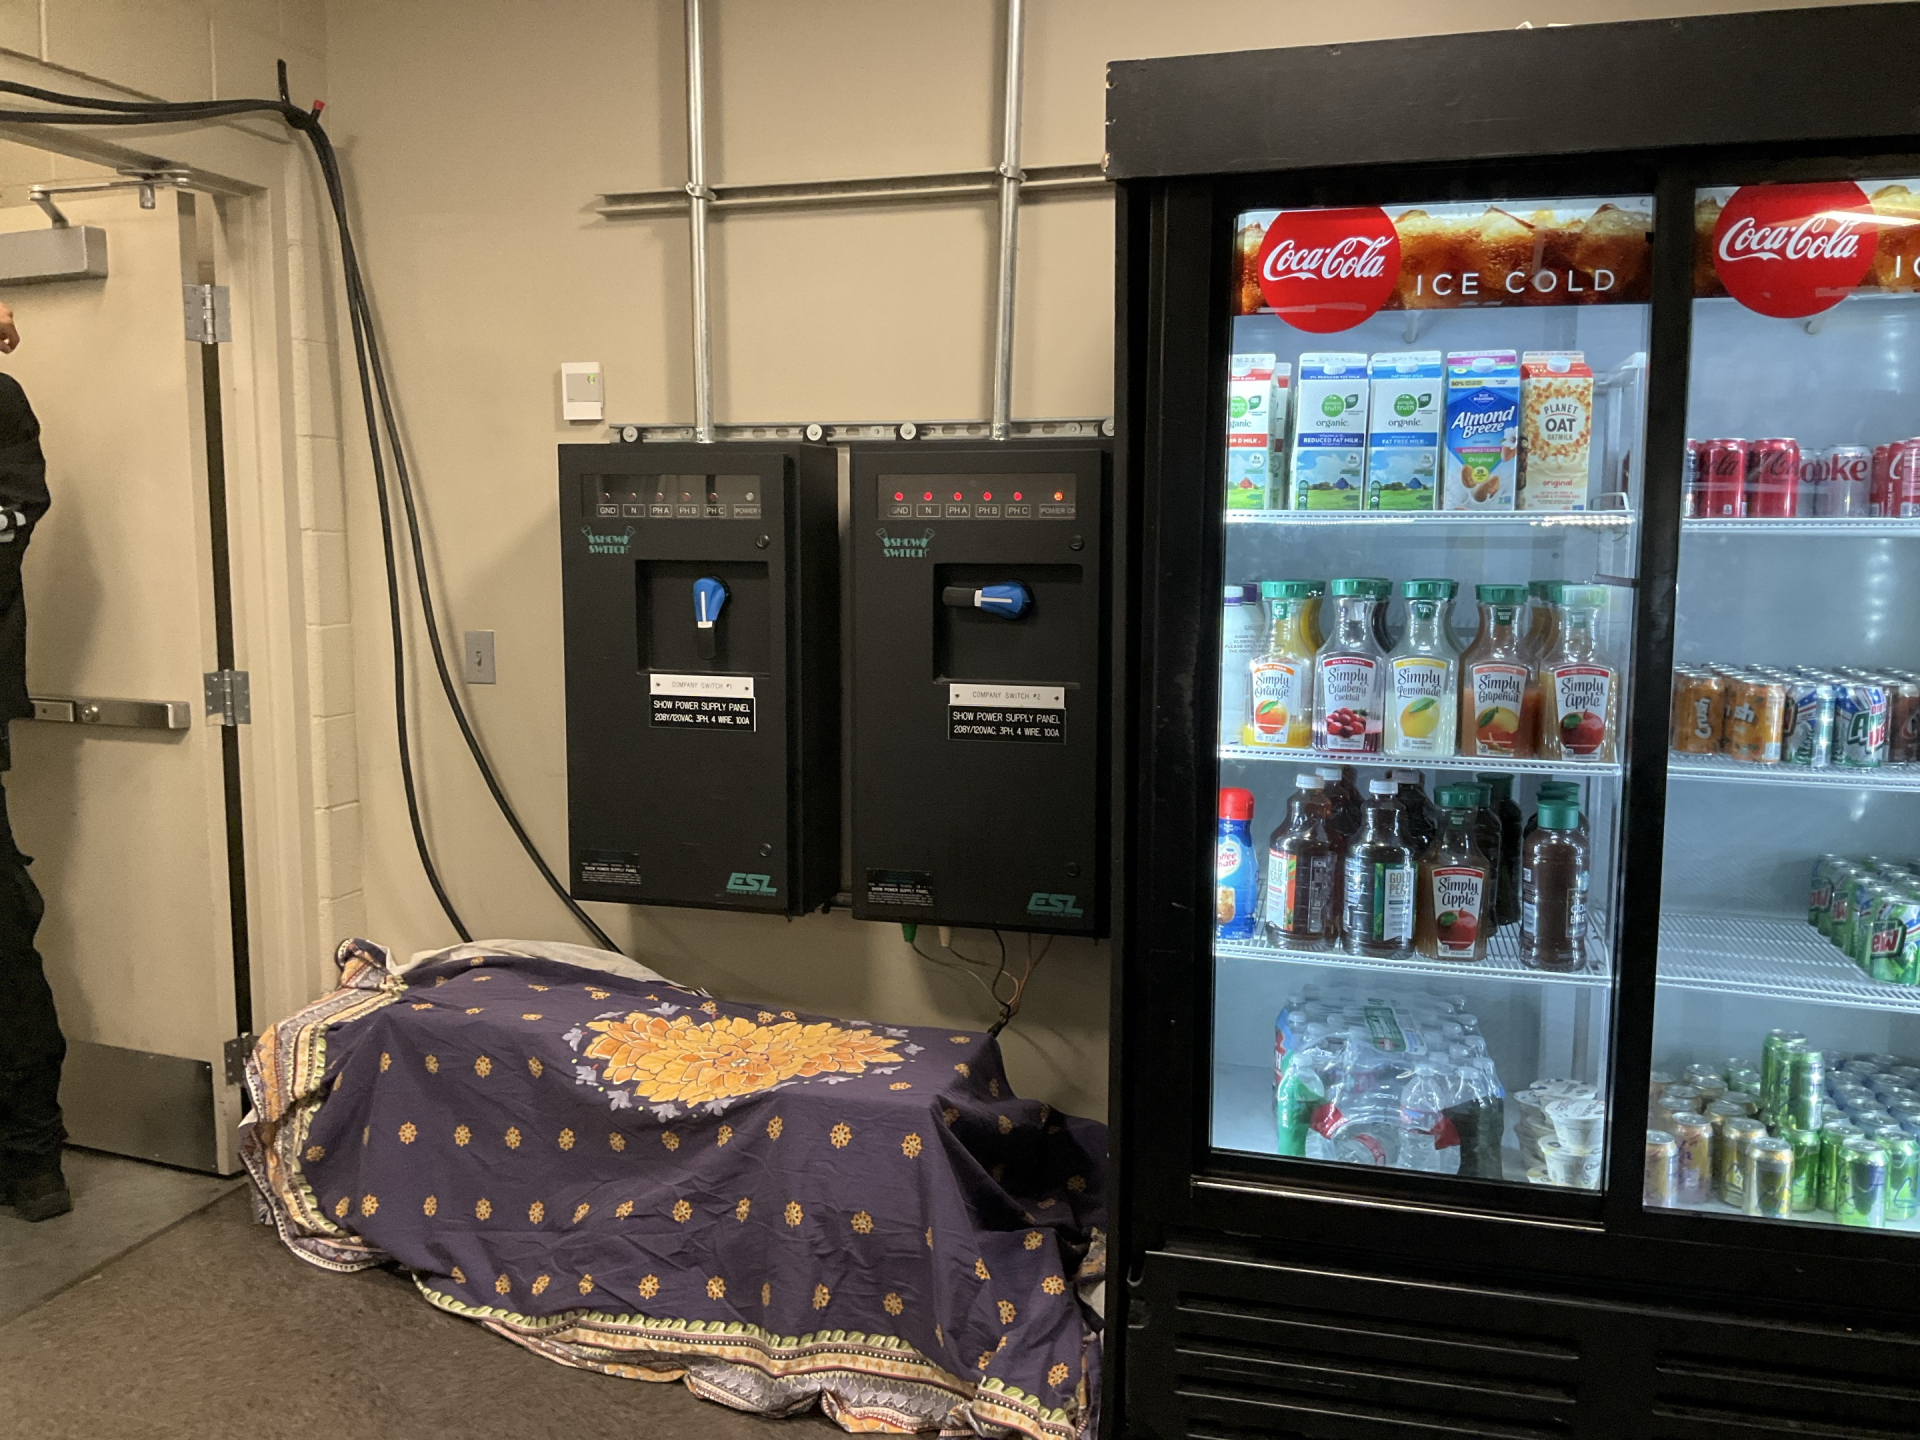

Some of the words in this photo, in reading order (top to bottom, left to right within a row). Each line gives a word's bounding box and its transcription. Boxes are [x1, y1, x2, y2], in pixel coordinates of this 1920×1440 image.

[1719, 210, 1860, 262] Coca-Cola
[1263, 235, 1395, 282] Coca-Cola
[1416, 273, 1479, 296] ICE
[1505, 269, 1615, 294] COLD
[1543, 403, 1579, 415] PLANET
[1316, 418, 1348, 428] organic
[1388, 418, 1421, 428] organic
[1451, 406, 1515, 429] Almond
[1230, 419, 1252, 429] ganic
[1545, 418, 1576, 432] OAT
[1462, 422, 1504, 439] Breeze
[1542, 479, 1573, 488] original
[599, 507, 616, 515] GND
[679, 507, 690, 515] PH
[691, 507, 697, 515] B
[706, 507, 717, 515] PH
[718, 507, 725, 515] C
[735, 507, 758, 515] POWER
[891, 506, 909, 514] GND
[925, 506, 932, 514] N
[949, 506, 961, 514] PH
[978, 506, 990, 515] PH
[992, 506, 998, 515] B
[1008, 507, 1020, 515] PH
[1021, 507, 1029, 515] C
[1040, 507, 1065, 515] POWER
[890, 538, 921, 547] SHOW
[883, 548, 928, 558] SWITCH
[1256, 672, 1290, 689] Simply
[1328, 666, 1369, 687] Simply
[1397, 667, 1442, 689] Simply
[672, 681, 698, 689] COMPANY
[701, 682, 724, 690] SWITCH
[1478, 674, 1521, 694] Simply
[1560, 676, 1606, 696] Simply
[972, 691, 1002, 699] COMPANY
[1005, 692, 1030, 700] SWITCH
[1255, 685, 1291, 700] Orange
[1328, 682, 1367, 698] Cranberry
[1396, 685, 1442, 700] Lemonade
[1478, 690, 1520, 703] Grapefruit
[653, 699, 673, 709] SHOW
[675, 700, 699, 710] POWER
[701, 701, 727, 711] SUPPLY
[728, 703, 750, 712] PANEL
[710, 715, 716, 723] 4
[736, 716, 750, 725] 100A
[952, 711, 974, 721] SHOW
[976, 712, 1003, 722] POWER
[1005, 713, 1034, 723] SUPPLY
[1036, 714, 1061, 724] PANEL
[1016, 727, 1022, 735] 4
[1044, 728, 1060, 737] 100A
[1218, 852, 1237, 860] offee
[726, 872, 778, 893] ESL
[1438, 876, 1479, 896] Simply
[1026, 892, 1084, 915] ESL
